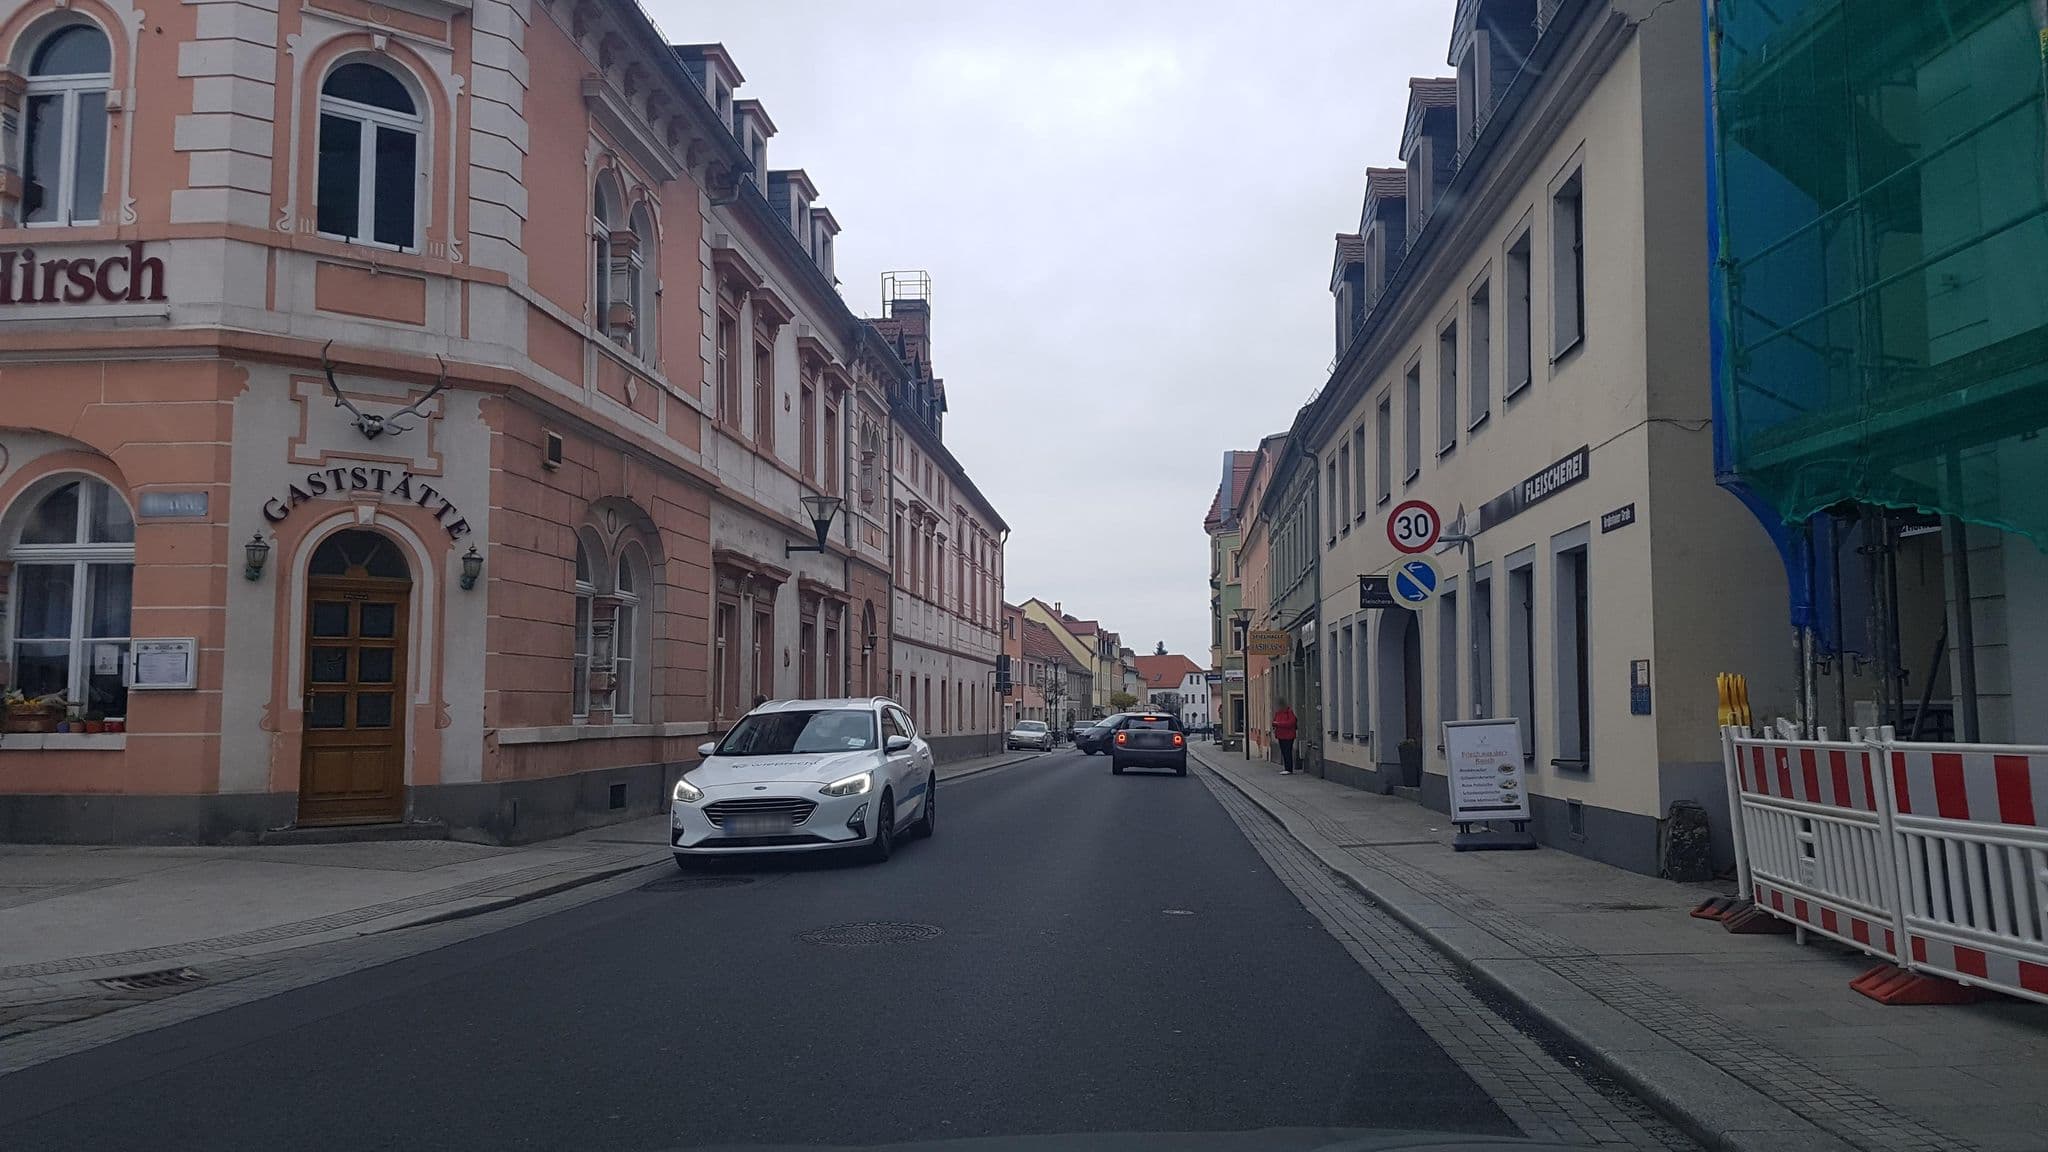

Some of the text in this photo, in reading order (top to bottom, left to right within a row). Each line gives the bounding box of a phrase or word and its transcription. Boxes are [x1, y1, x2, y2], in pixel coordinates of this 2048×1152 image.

[1525, 453, 1583, 503] FLEISCHEREI
[263, 467, 472, 540] GASTSTÄTTE
[1398, 513, 1429, 540] 30
